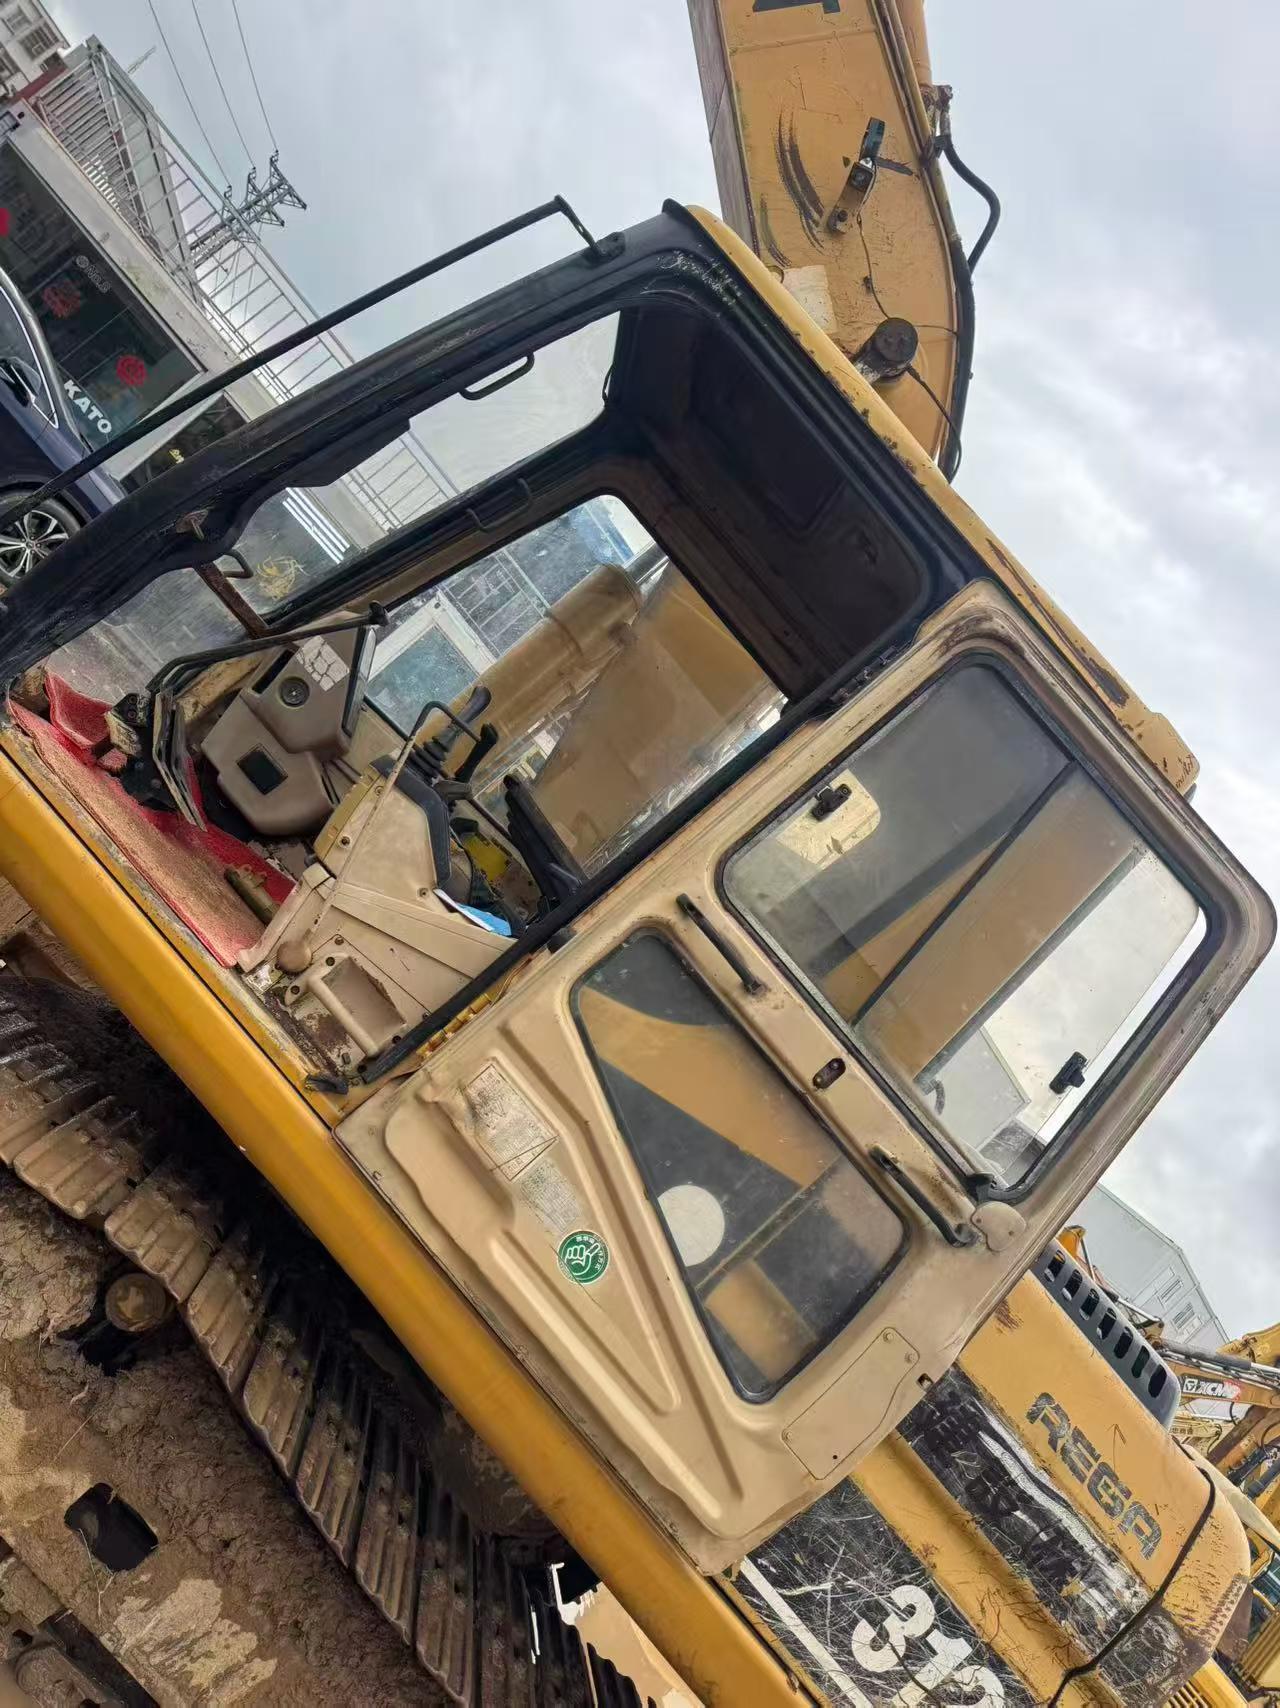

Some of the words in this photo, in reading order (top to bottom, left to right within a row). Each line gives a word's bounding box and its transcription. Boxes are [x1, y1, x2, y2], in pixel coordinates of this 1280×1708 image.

[63, 380, 112, 434] KATO
[1196, 1381, 1240, 1399] XCM
[1027, 1391, 1161, 1560] REGA
